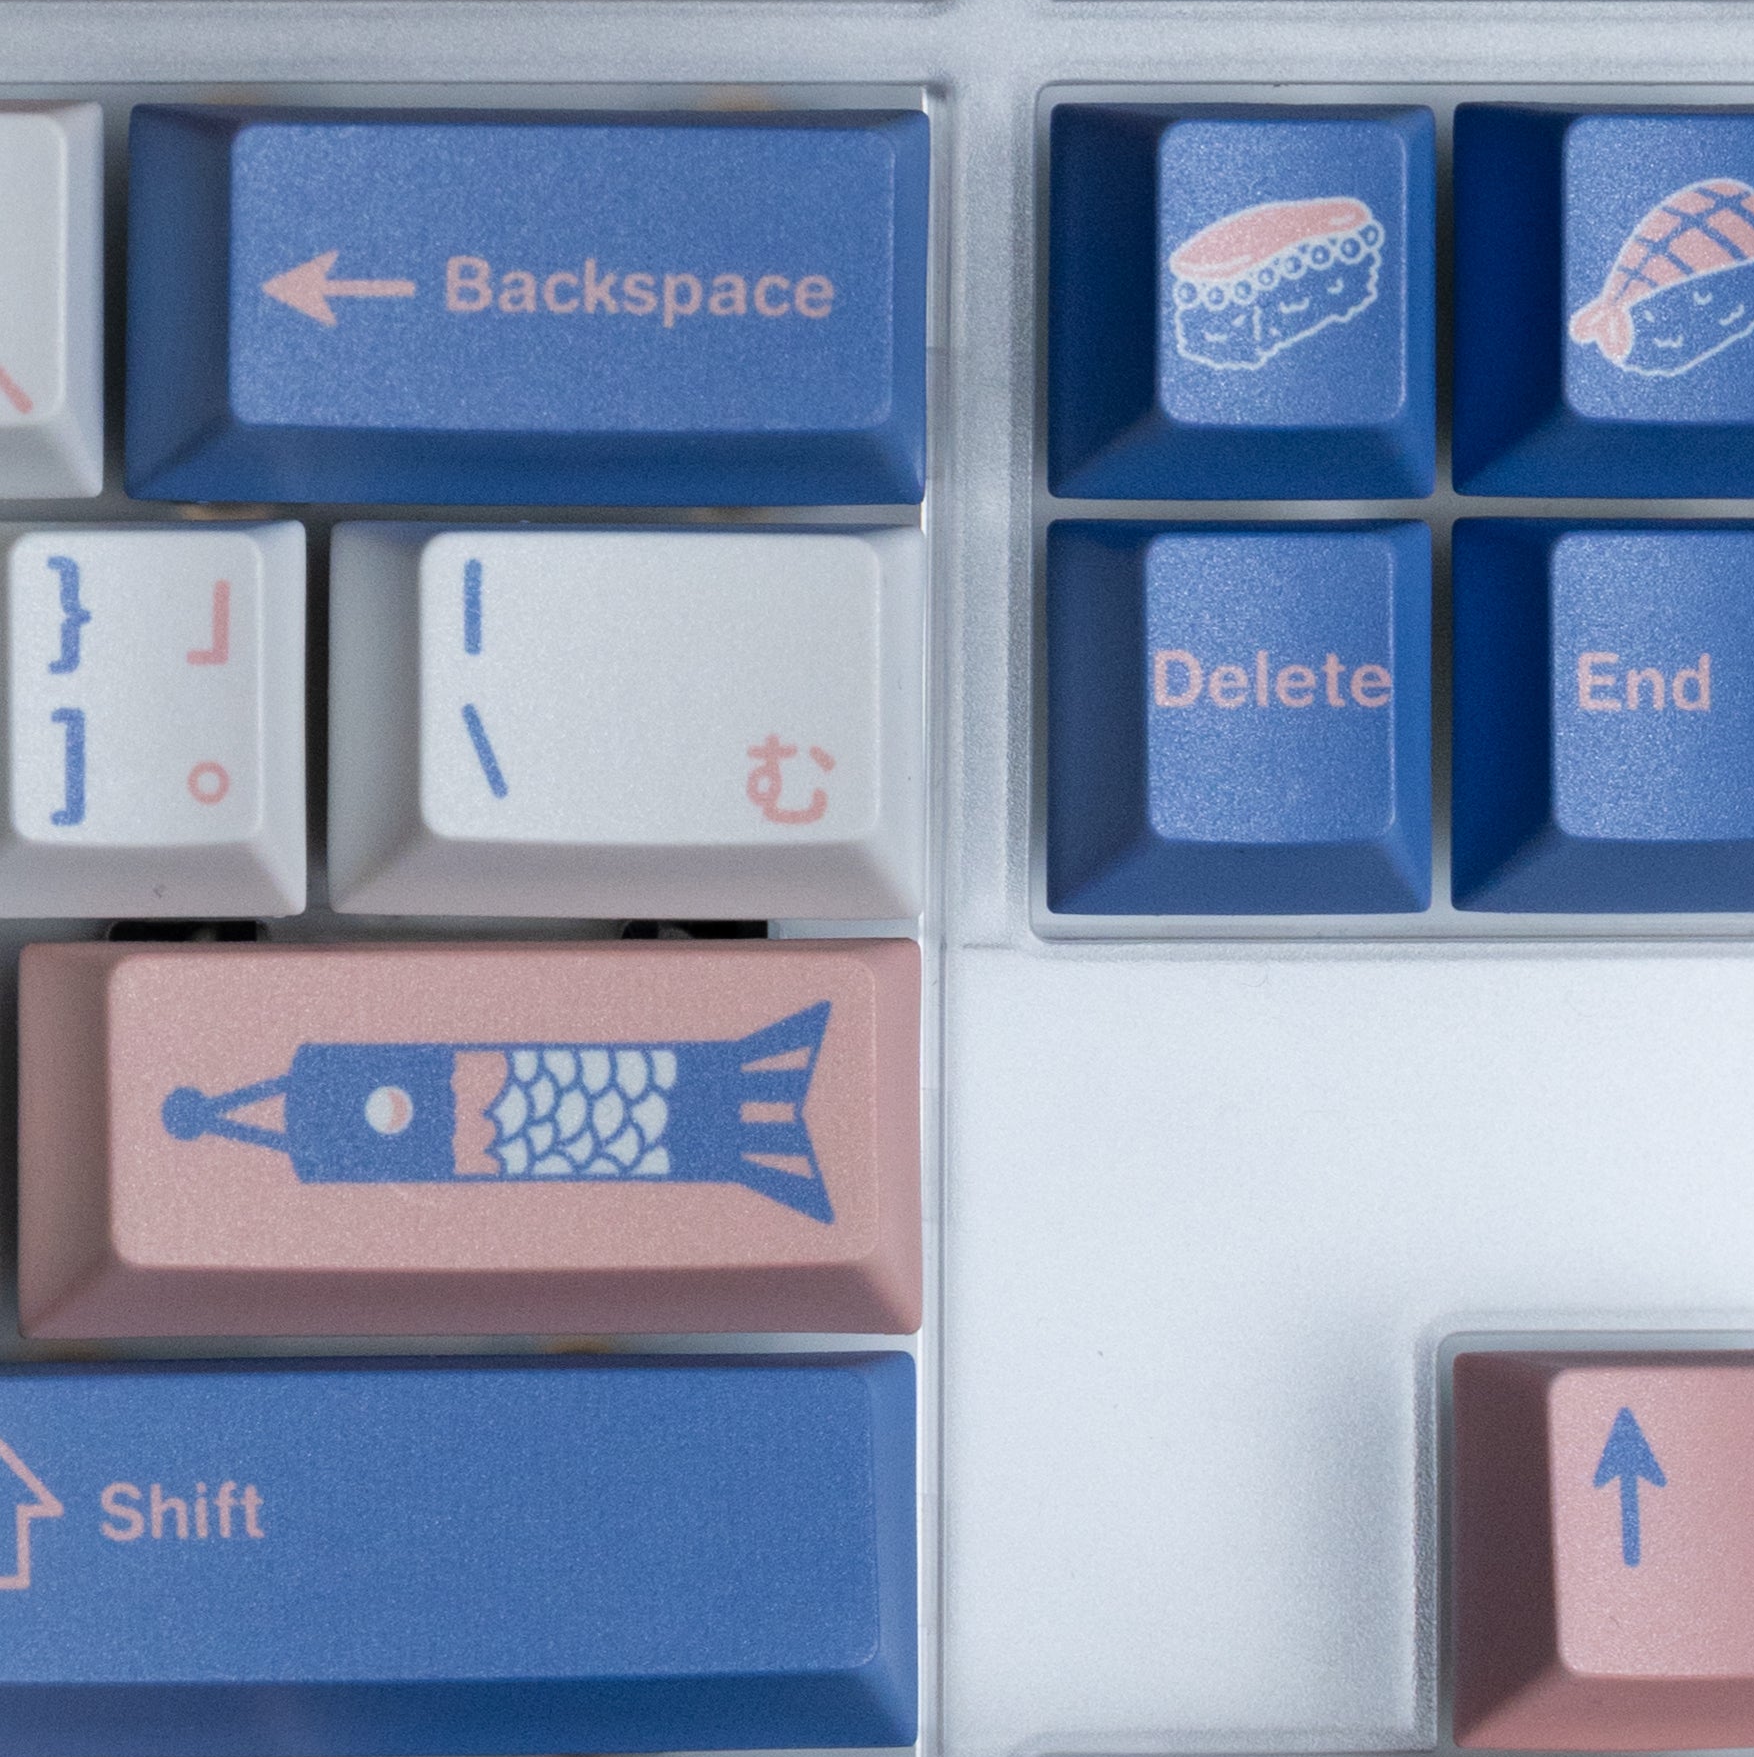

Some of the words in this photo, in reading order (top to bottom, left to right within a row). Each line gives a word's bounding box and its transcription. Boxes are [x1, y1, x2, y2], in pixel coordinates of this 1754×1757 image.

[443, 254, 836, 329] Backspace
[47, 555, 92, 675] }
[1151, 647, 1393, 711] Delete
[1575, 649, 1713, 713] End
[50, 707, 86, 827] ]
[461, 703, 509, 799] \
[746, 734, 837, 825] む
[100, 1479, 266, 1542] Shift
